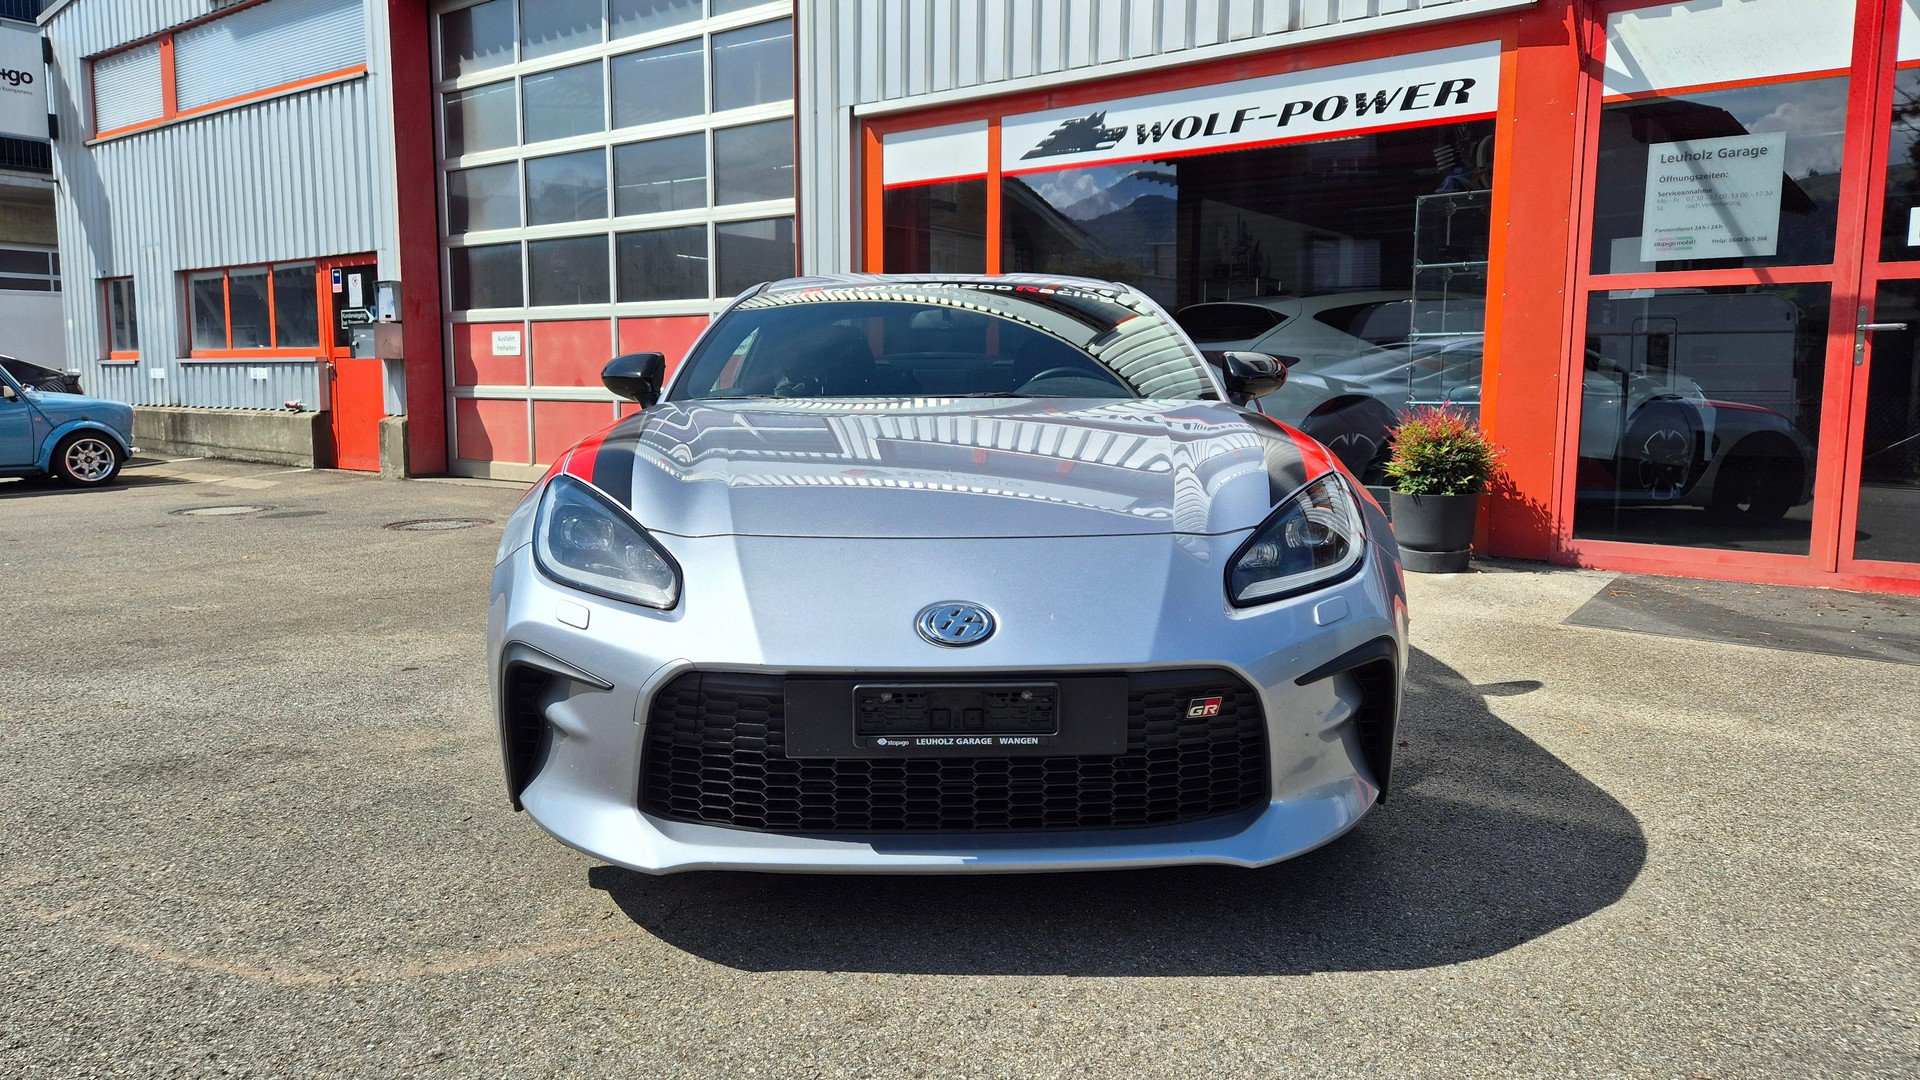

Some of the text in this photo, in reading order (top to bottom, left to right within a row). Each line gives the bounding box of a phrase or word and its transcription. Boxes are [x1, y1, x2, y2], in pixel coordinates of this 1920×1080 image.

[1136, 77, 1476, 145] WOLF-POWER
[1660, 146, 1768, 164] Leuholz Garage
[1659, 171, 1729, 183] Öffnungszeiten:
[1657, 188, 1713, 198] Serviceannahme
[921, 282, 1013, 291] GAZOO
[1015, 285, 1115, 304] Racing
[1189, 704, 1218, 716] GR
[1000, 737, 1039, 745] WANGEN
